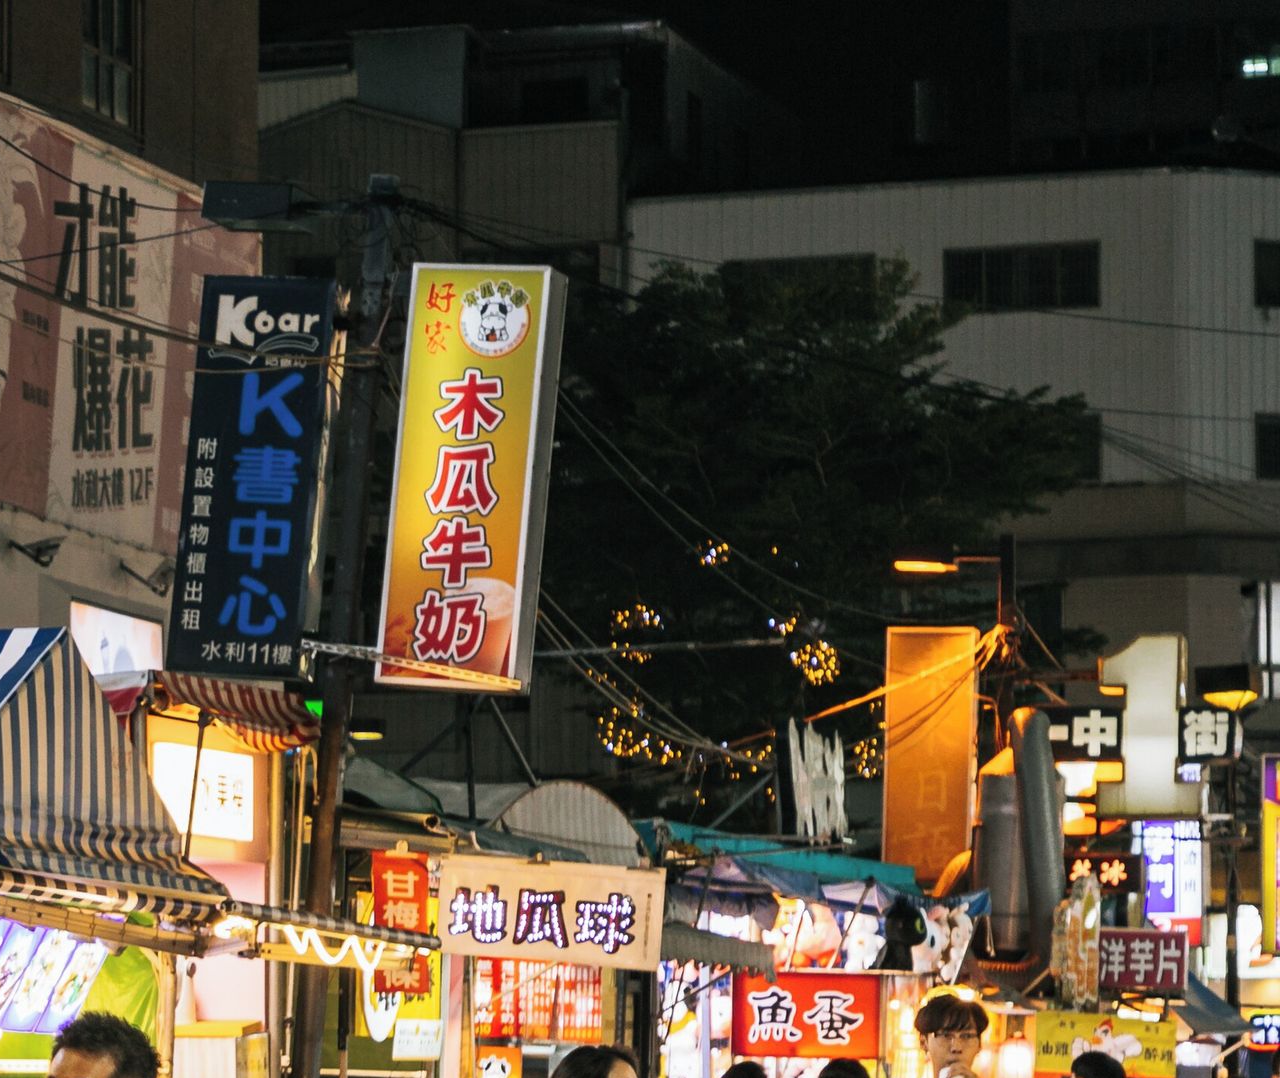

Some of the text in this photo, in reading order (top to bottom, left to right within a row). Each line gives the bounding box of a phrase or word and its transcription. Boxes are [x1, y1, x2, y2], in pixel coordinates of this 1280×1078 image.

[181, 437, 218, 630] 附設置物櫃出租
[218, 371, 304, 635] K書中心
[414, 367, 504, 665] 木瓜牛奶
[201, 639, 292, 667] 水利11樓
[448, 885, 636, 953] 地瓜球
[1100, 938, 1183, 984] 洋芋片
[747, 986, 864, 1046] 魚蛋
